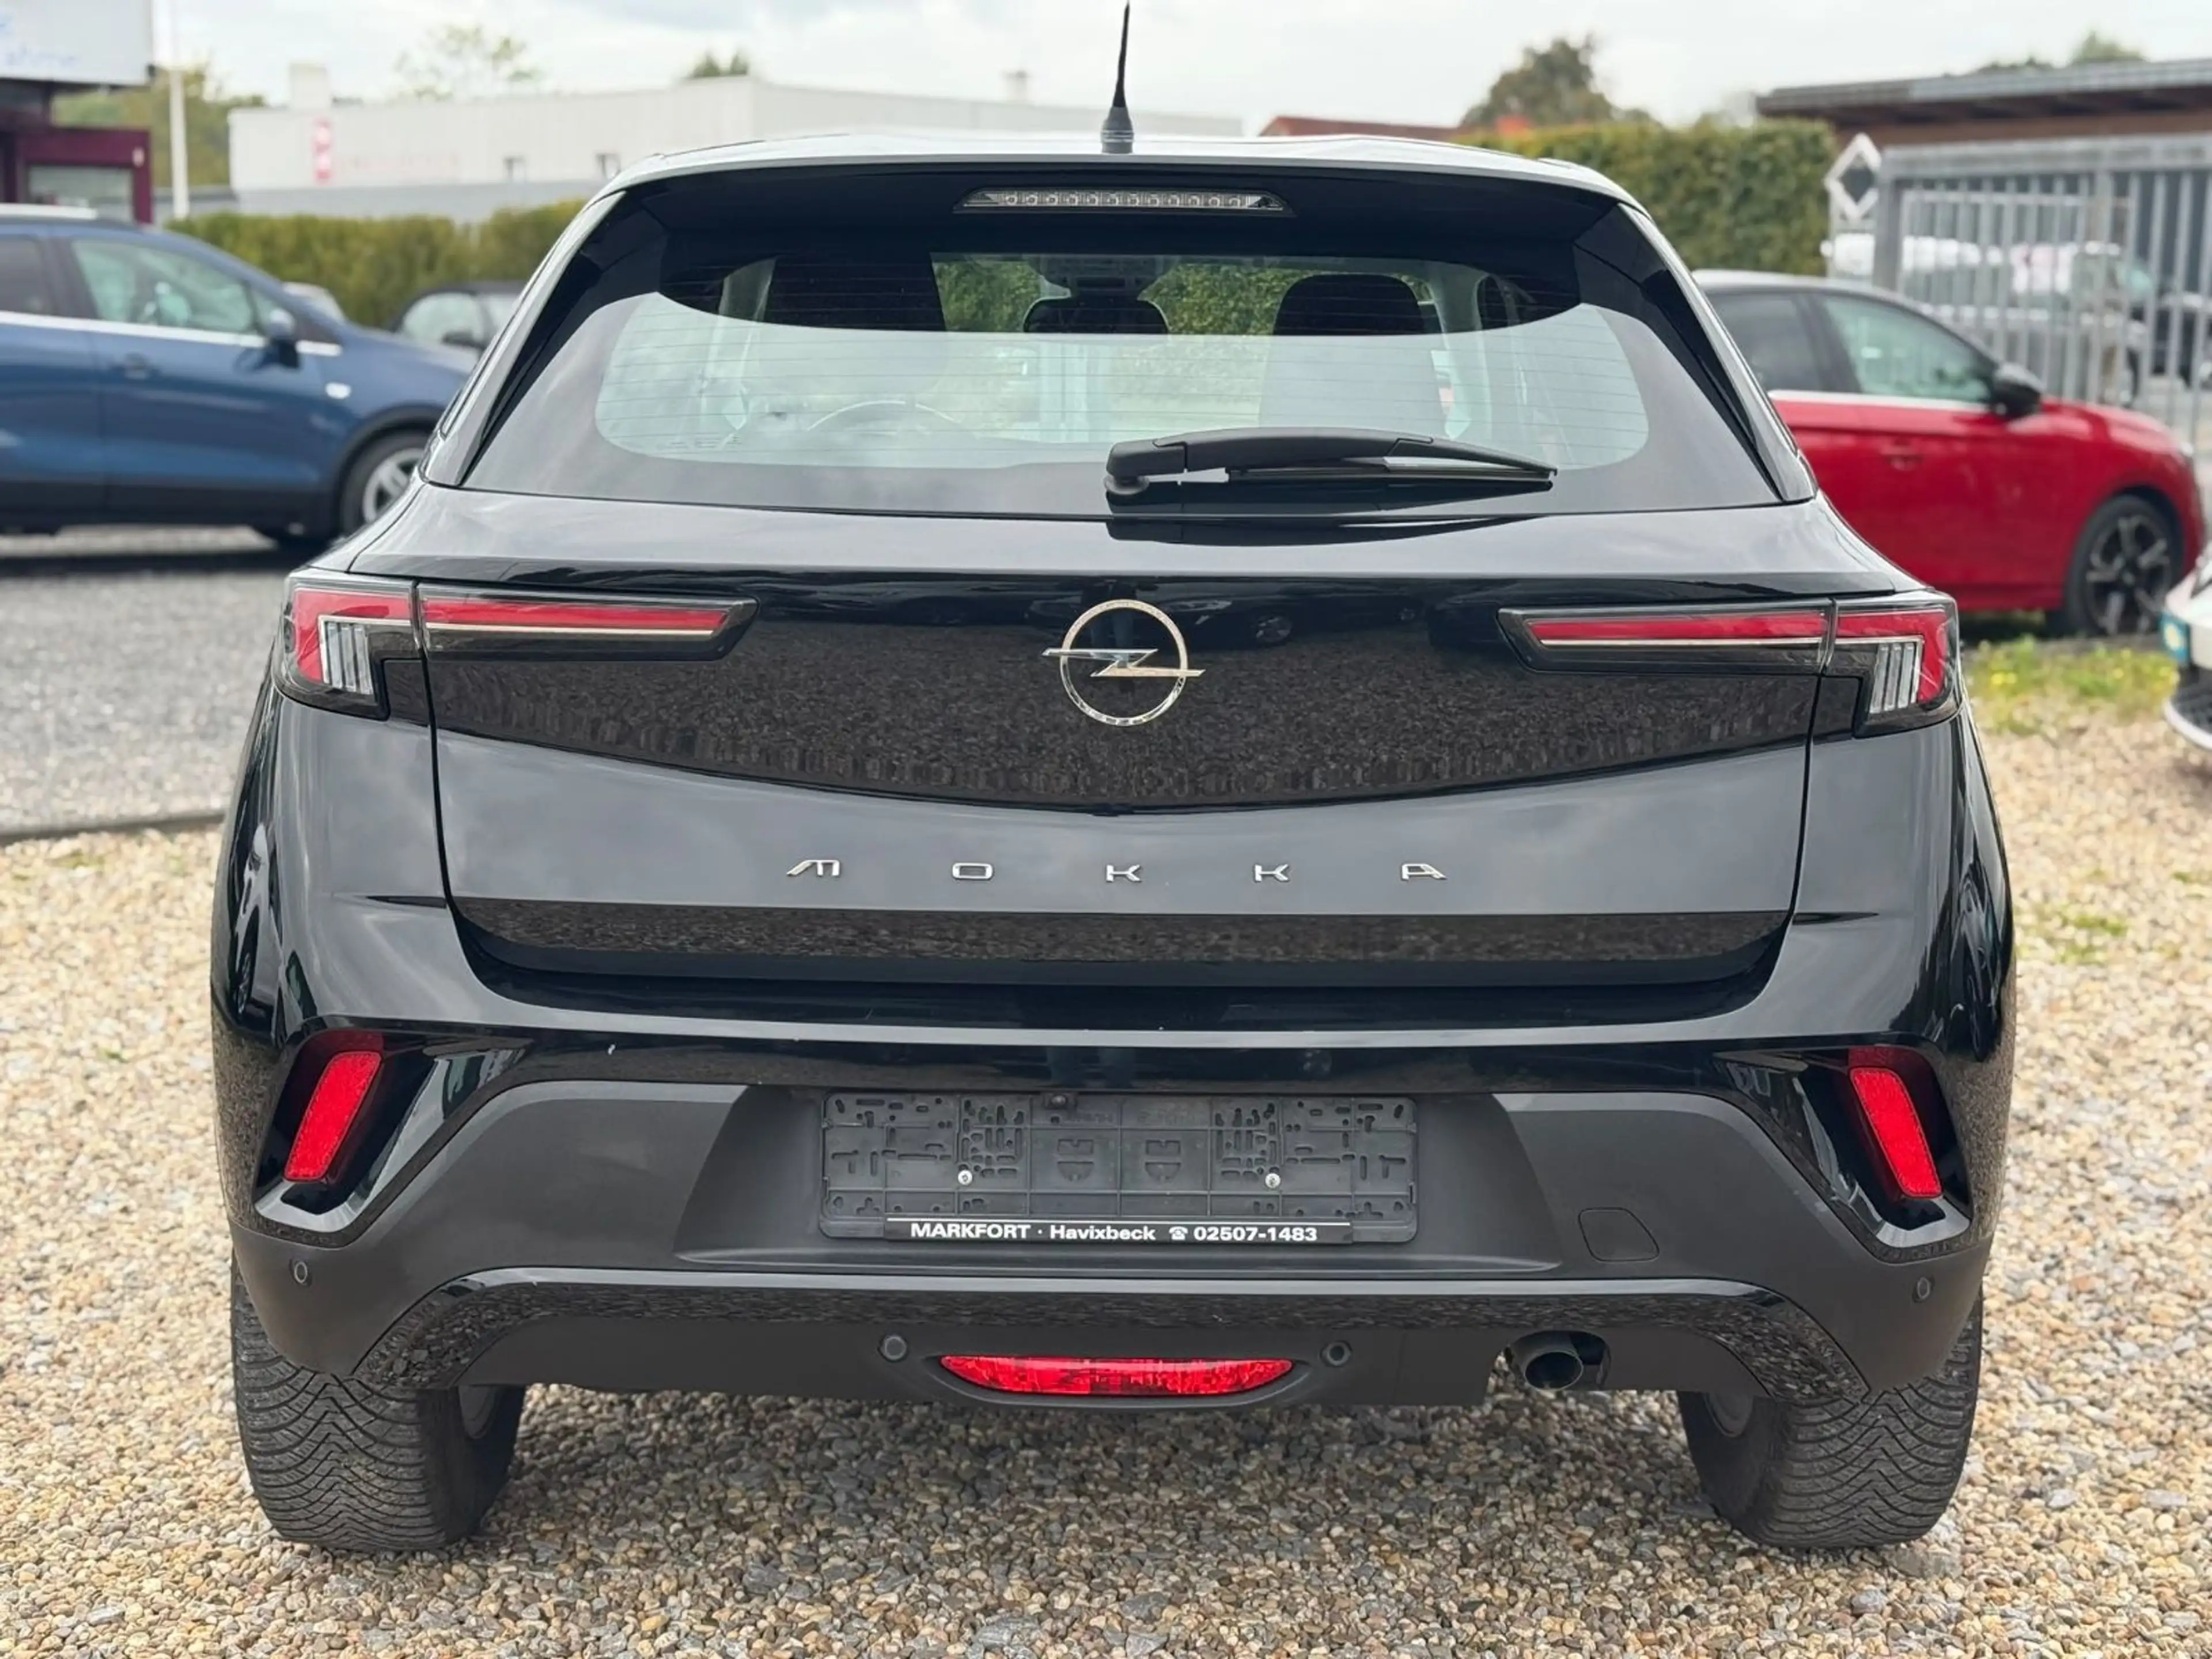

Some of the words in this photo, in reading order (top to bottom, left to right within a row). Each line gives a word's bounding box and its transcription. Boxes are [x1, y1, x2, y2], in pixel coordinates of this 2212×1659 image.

[786, 859, 1446, 880] MOKKA
[910, 1222, 1031, 1239] MARKFORT
[1050, 1224, 1156, 1240] Havixbeck
[1193, 1226, 1318, 1241] 02507-1483
